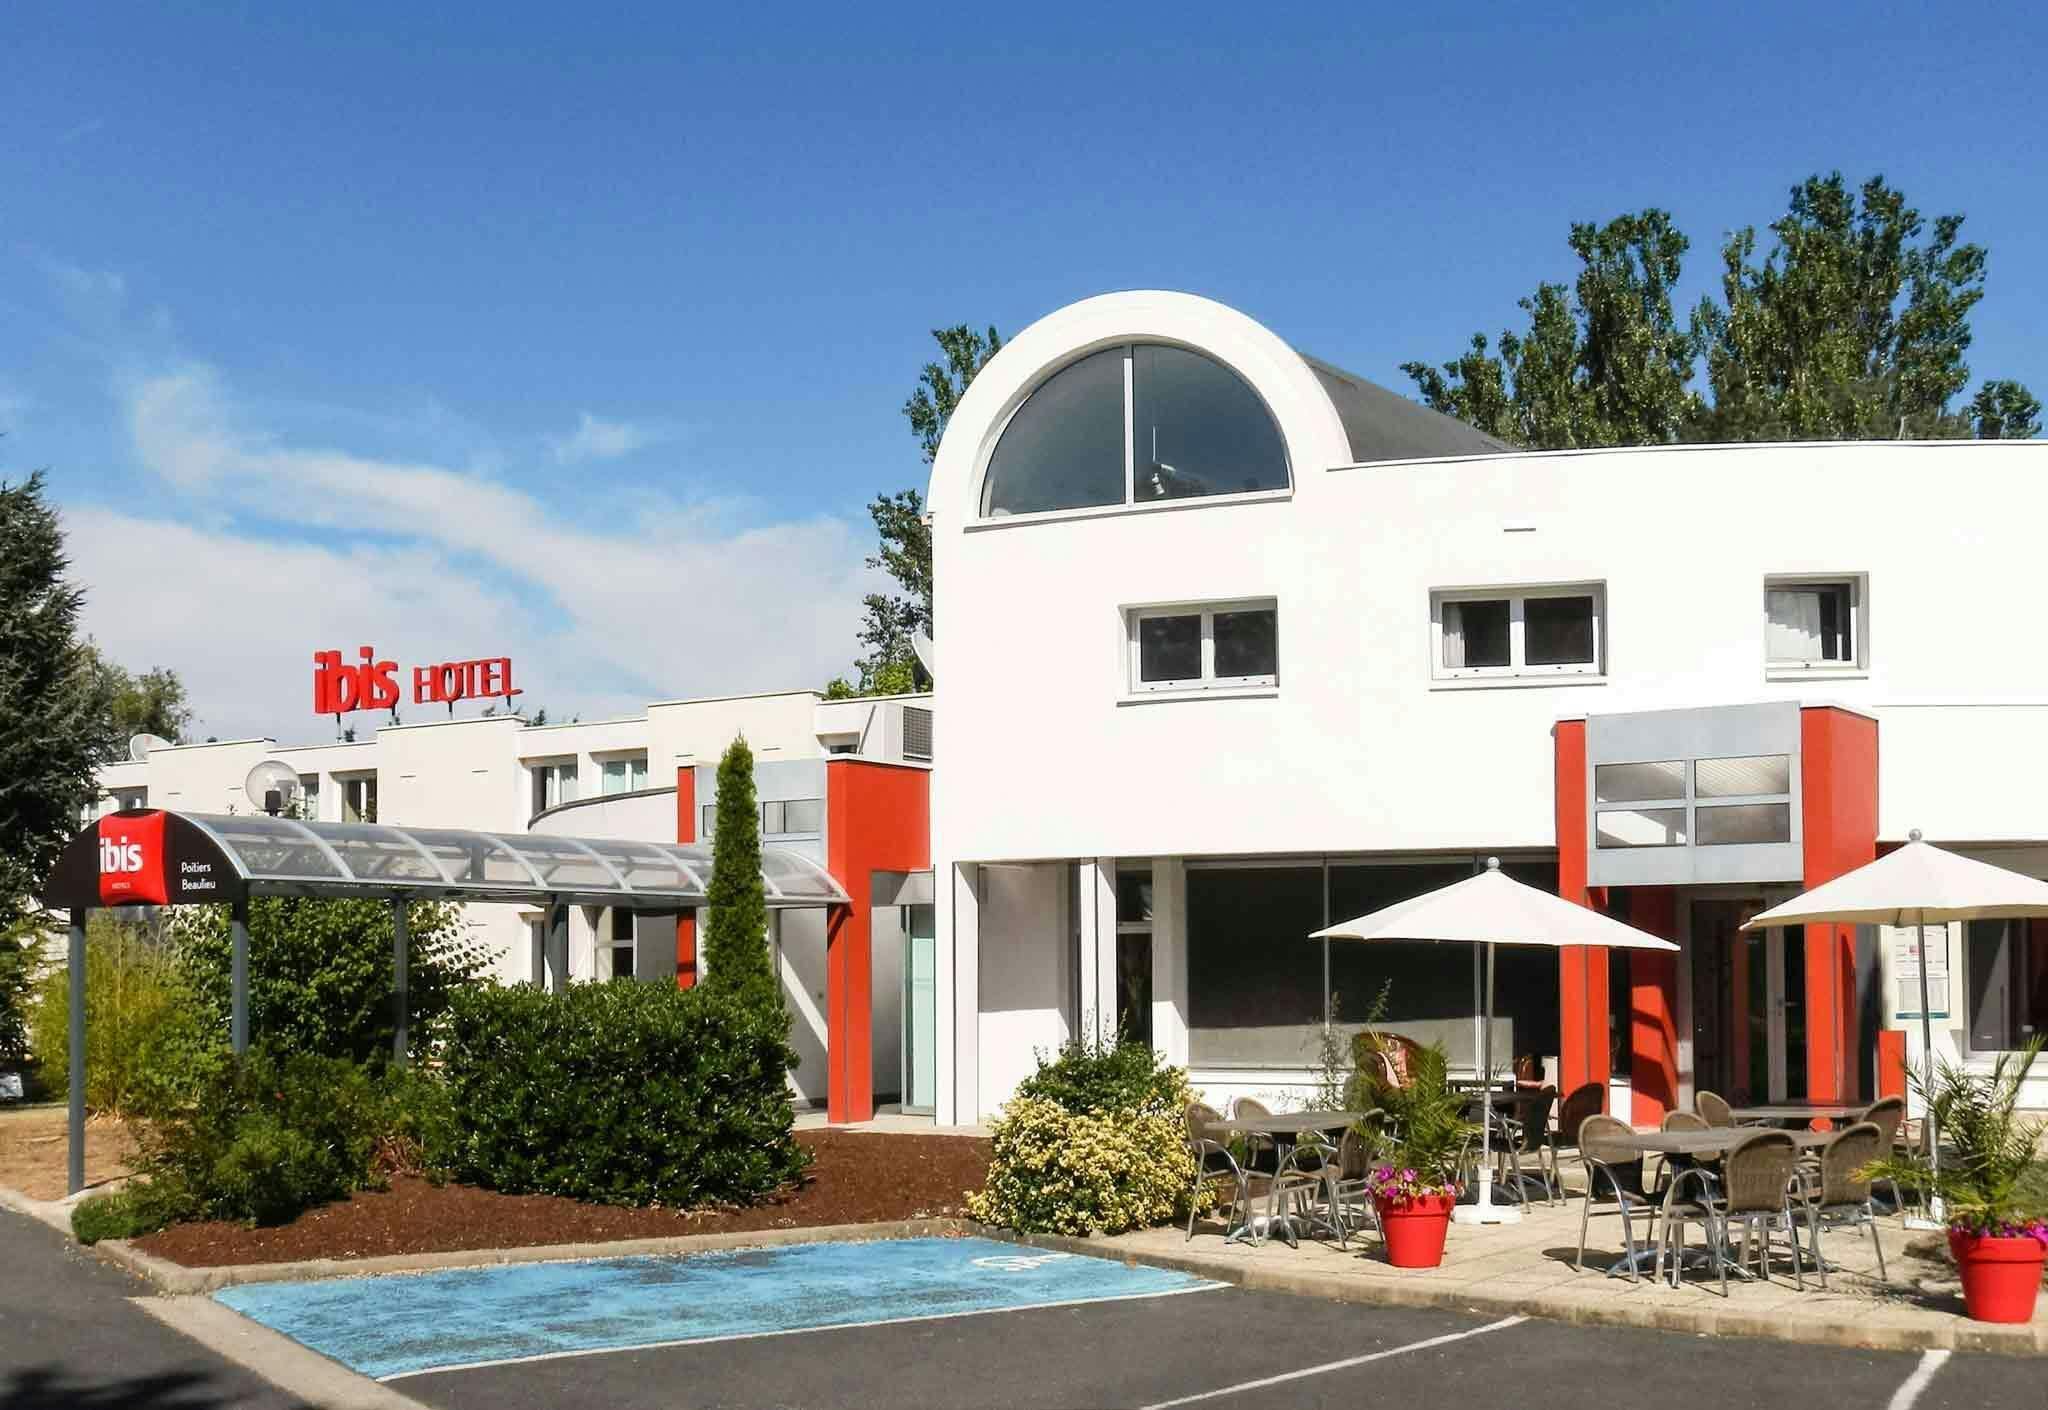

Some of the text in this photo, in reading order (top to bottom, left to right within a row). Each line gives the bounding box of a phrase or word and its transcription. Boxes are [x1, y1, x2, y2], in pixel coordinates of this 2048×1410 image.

[314, 646, 524, 714] ibis HOTEL
[99, 836, 144, 873] ibis
[181, 861, 212, 873] Poitiers
[182, 878, 216, 890] Beaulieu
